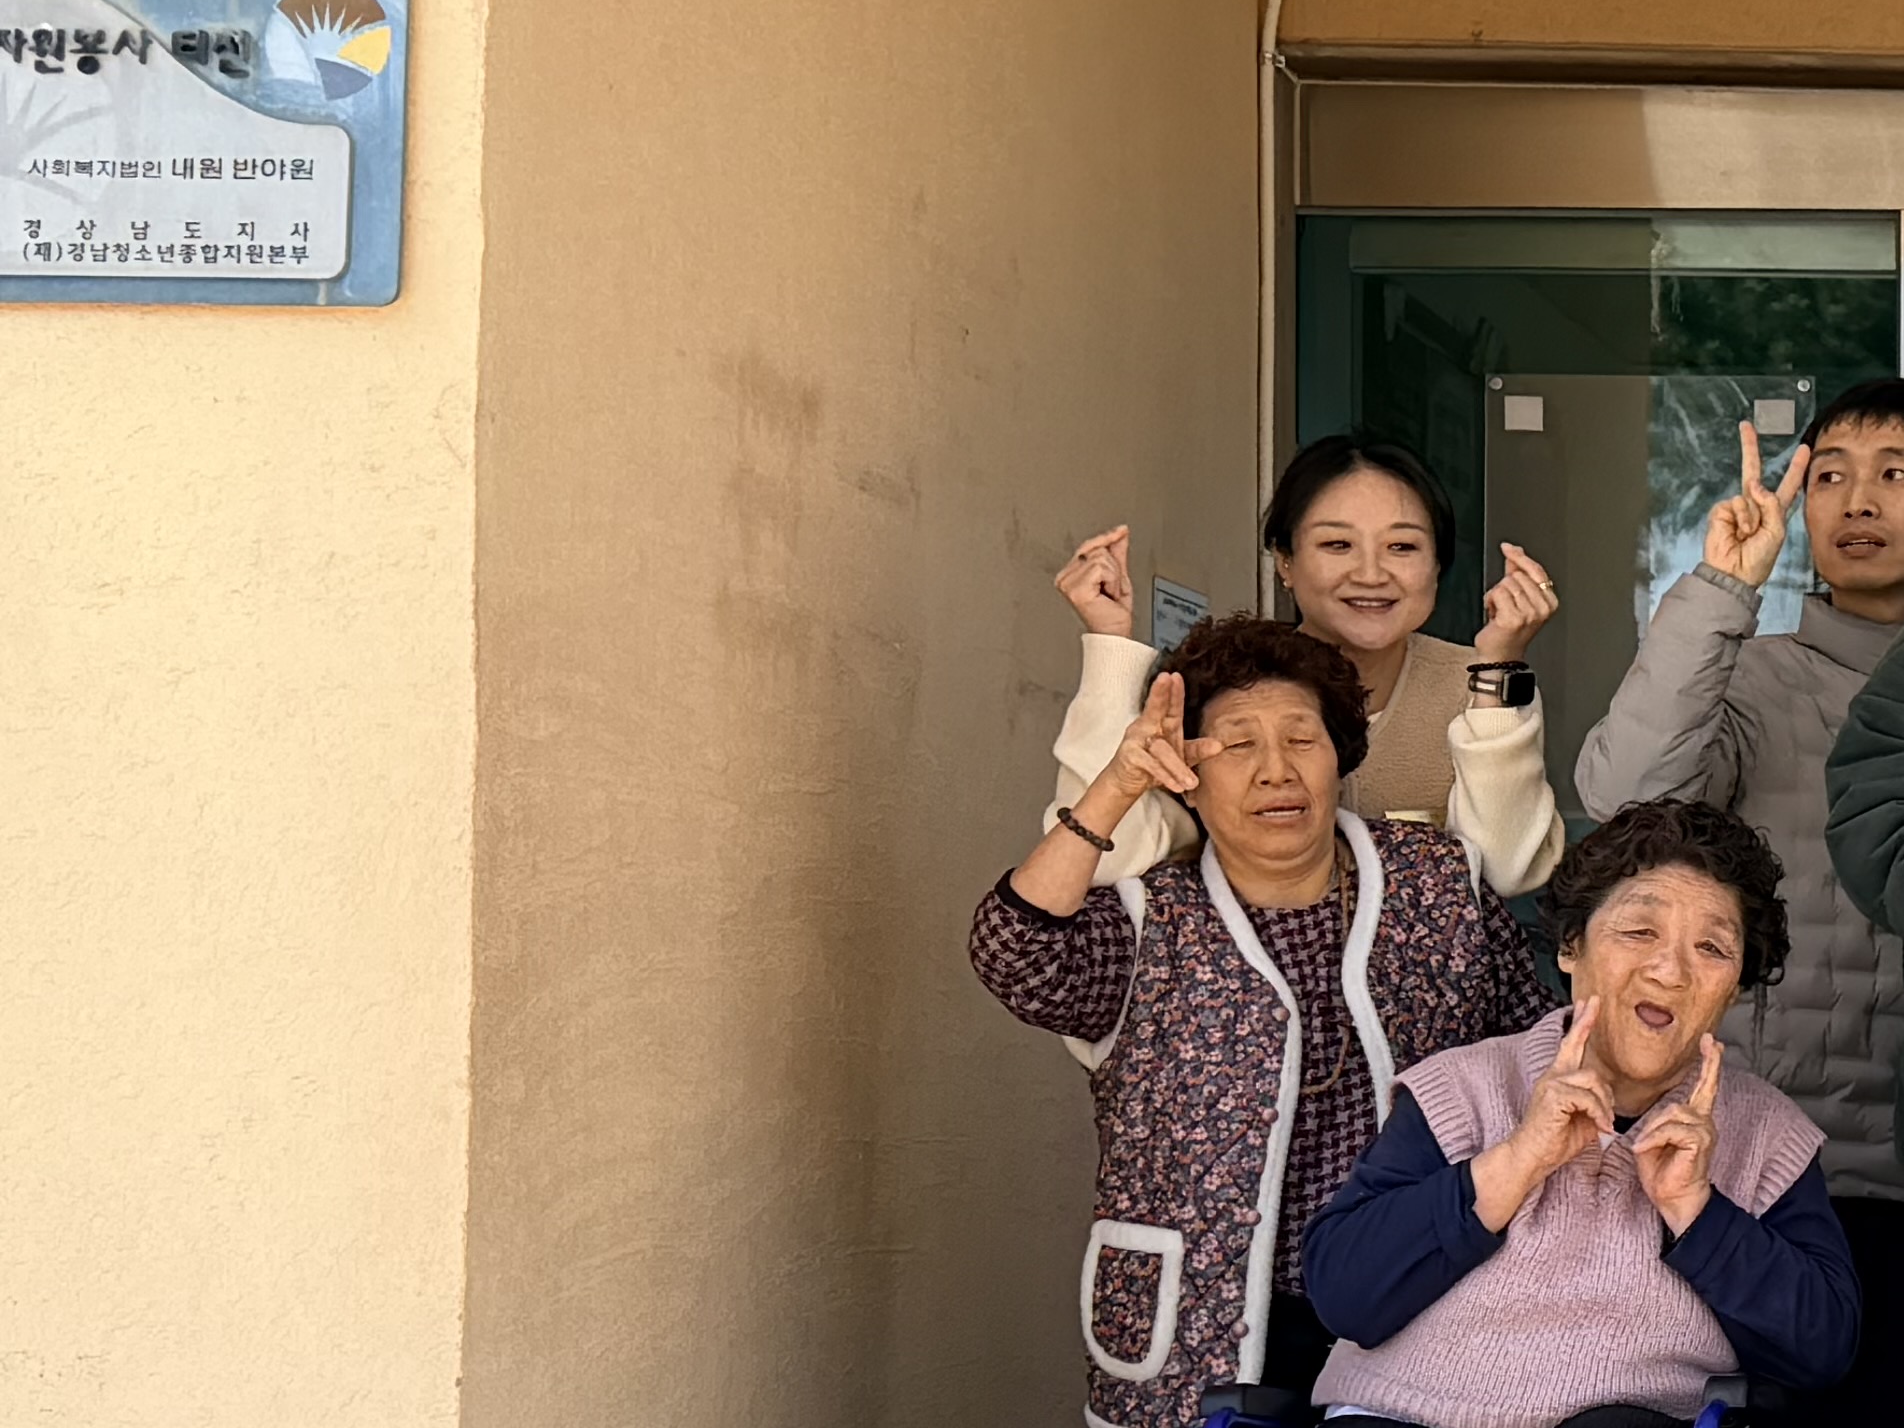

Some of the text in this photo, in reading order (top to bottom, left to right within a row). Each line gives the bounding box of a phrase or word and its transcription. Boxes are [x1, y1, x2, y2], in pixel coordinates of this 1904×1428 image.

[27, 157, 314, 181] 사회복지법인 내원 반야원
